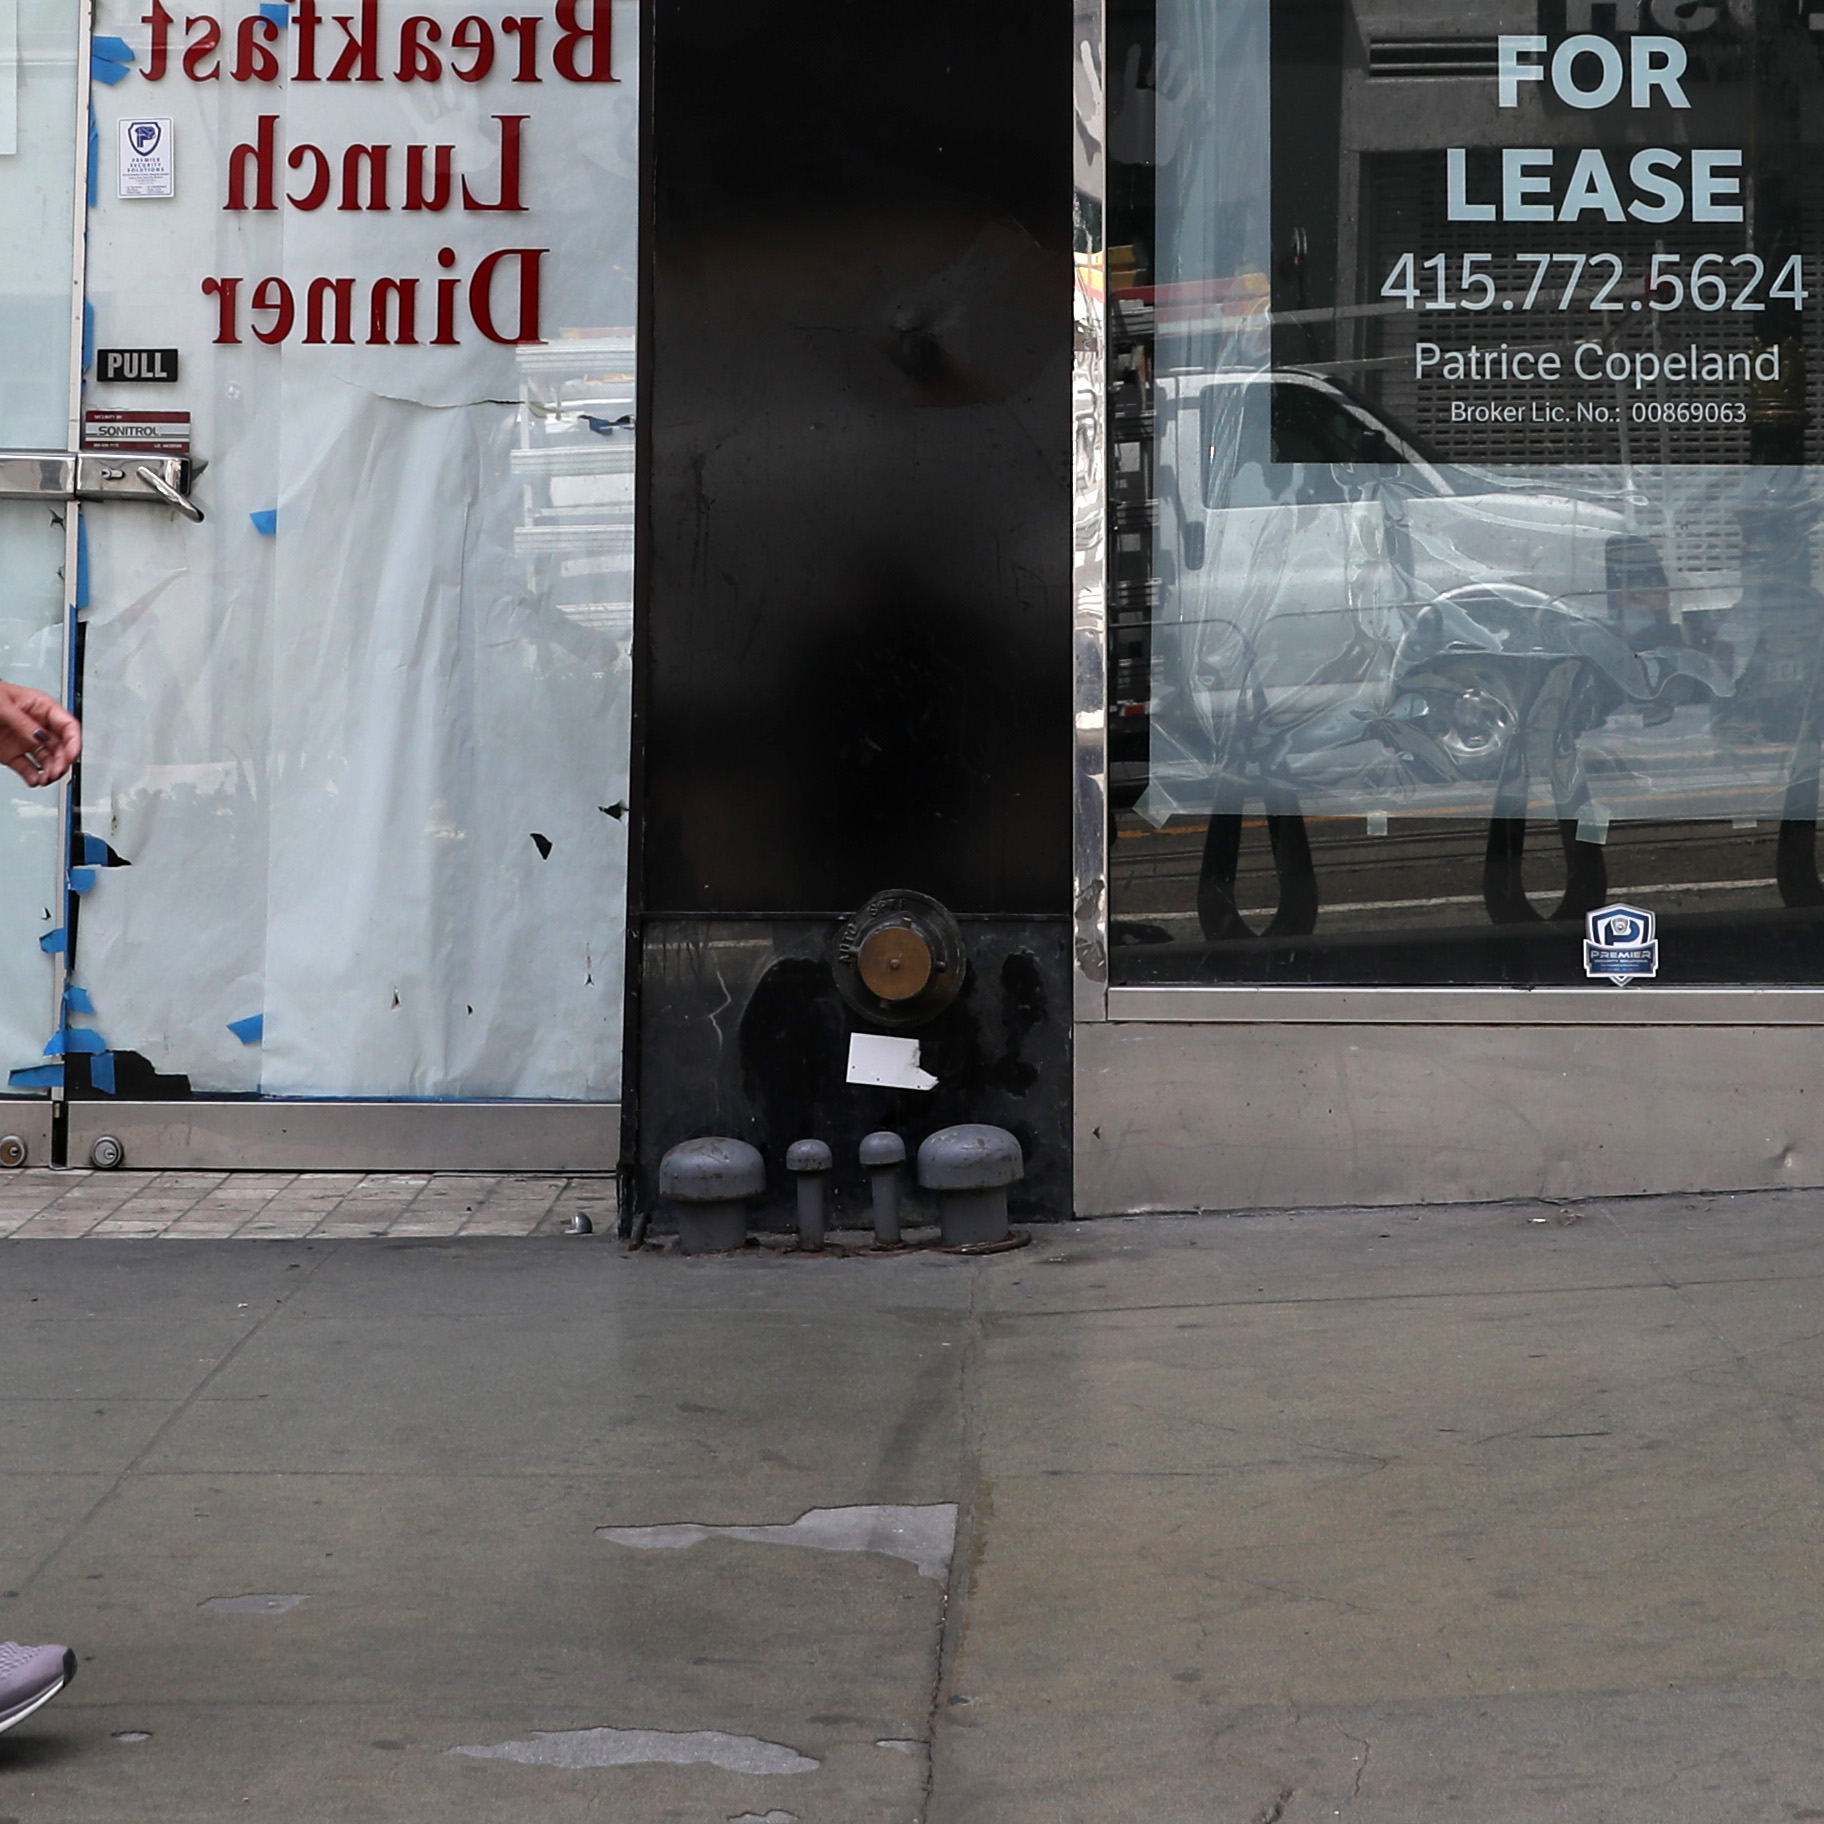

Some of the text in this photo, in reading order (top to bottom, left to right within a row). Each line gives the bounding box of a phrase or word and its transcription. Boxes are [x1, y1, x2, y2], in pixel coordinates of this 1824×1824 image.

[1499, 35, 1690, 108] FOR
[1447, 149, 1743, 222] LEASE
[1380, 253, 1809, 311] 415.772.5624
[107, 352, 168, 378] PULL
[1415, 342, 1780, 390] Patrice Copeland
[1451, 401, 1747, 423] Broker Lic. No.: 00869063
[98, 426, 160, 436] SONITROL
[1591, 950, 1651, 959] PREMIER
